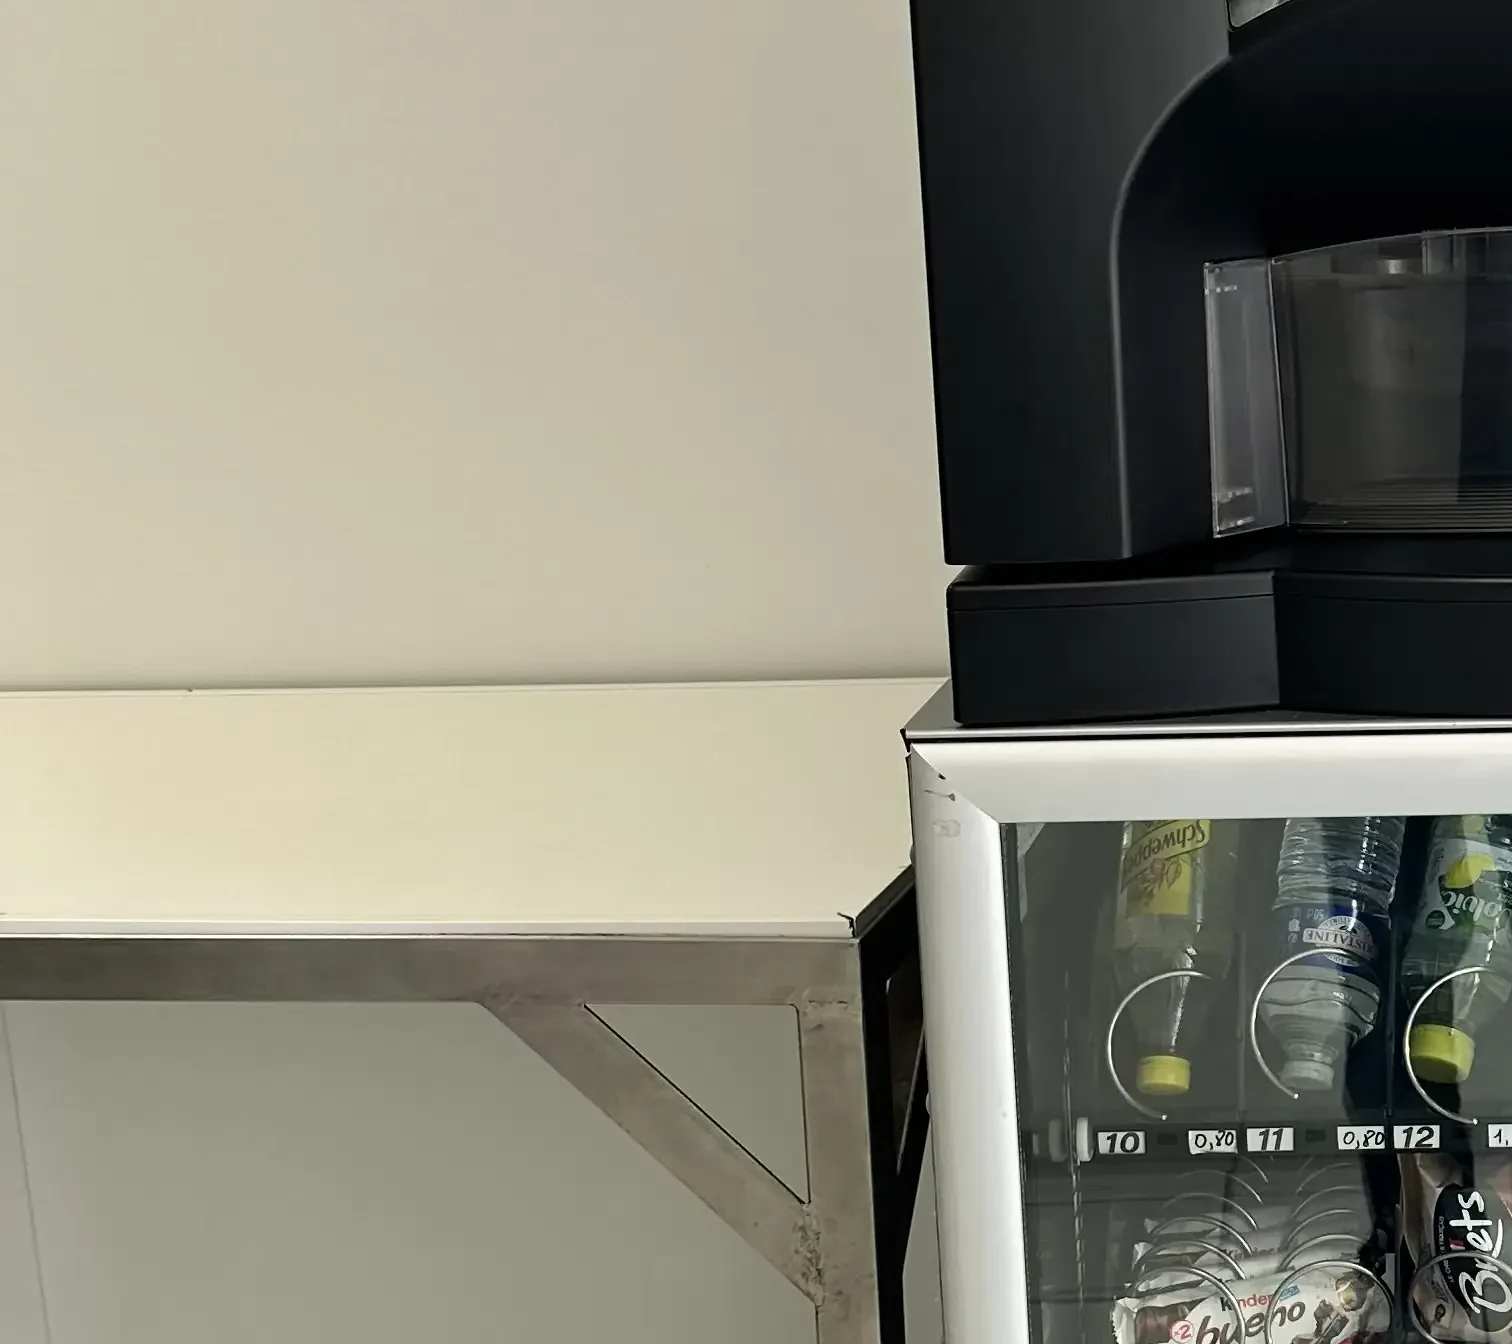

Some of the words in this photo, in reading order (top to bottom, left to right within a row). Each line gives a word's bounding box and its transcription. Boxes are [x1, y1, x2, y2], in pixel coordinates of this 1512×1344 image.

[1105, 1131, 1140, 1153] 10
[1257, 1129, 1286, 1150] 11
[1401, 1126, 1435, 1147] 12
[1450, 1190, 1512, 1314] Brets
